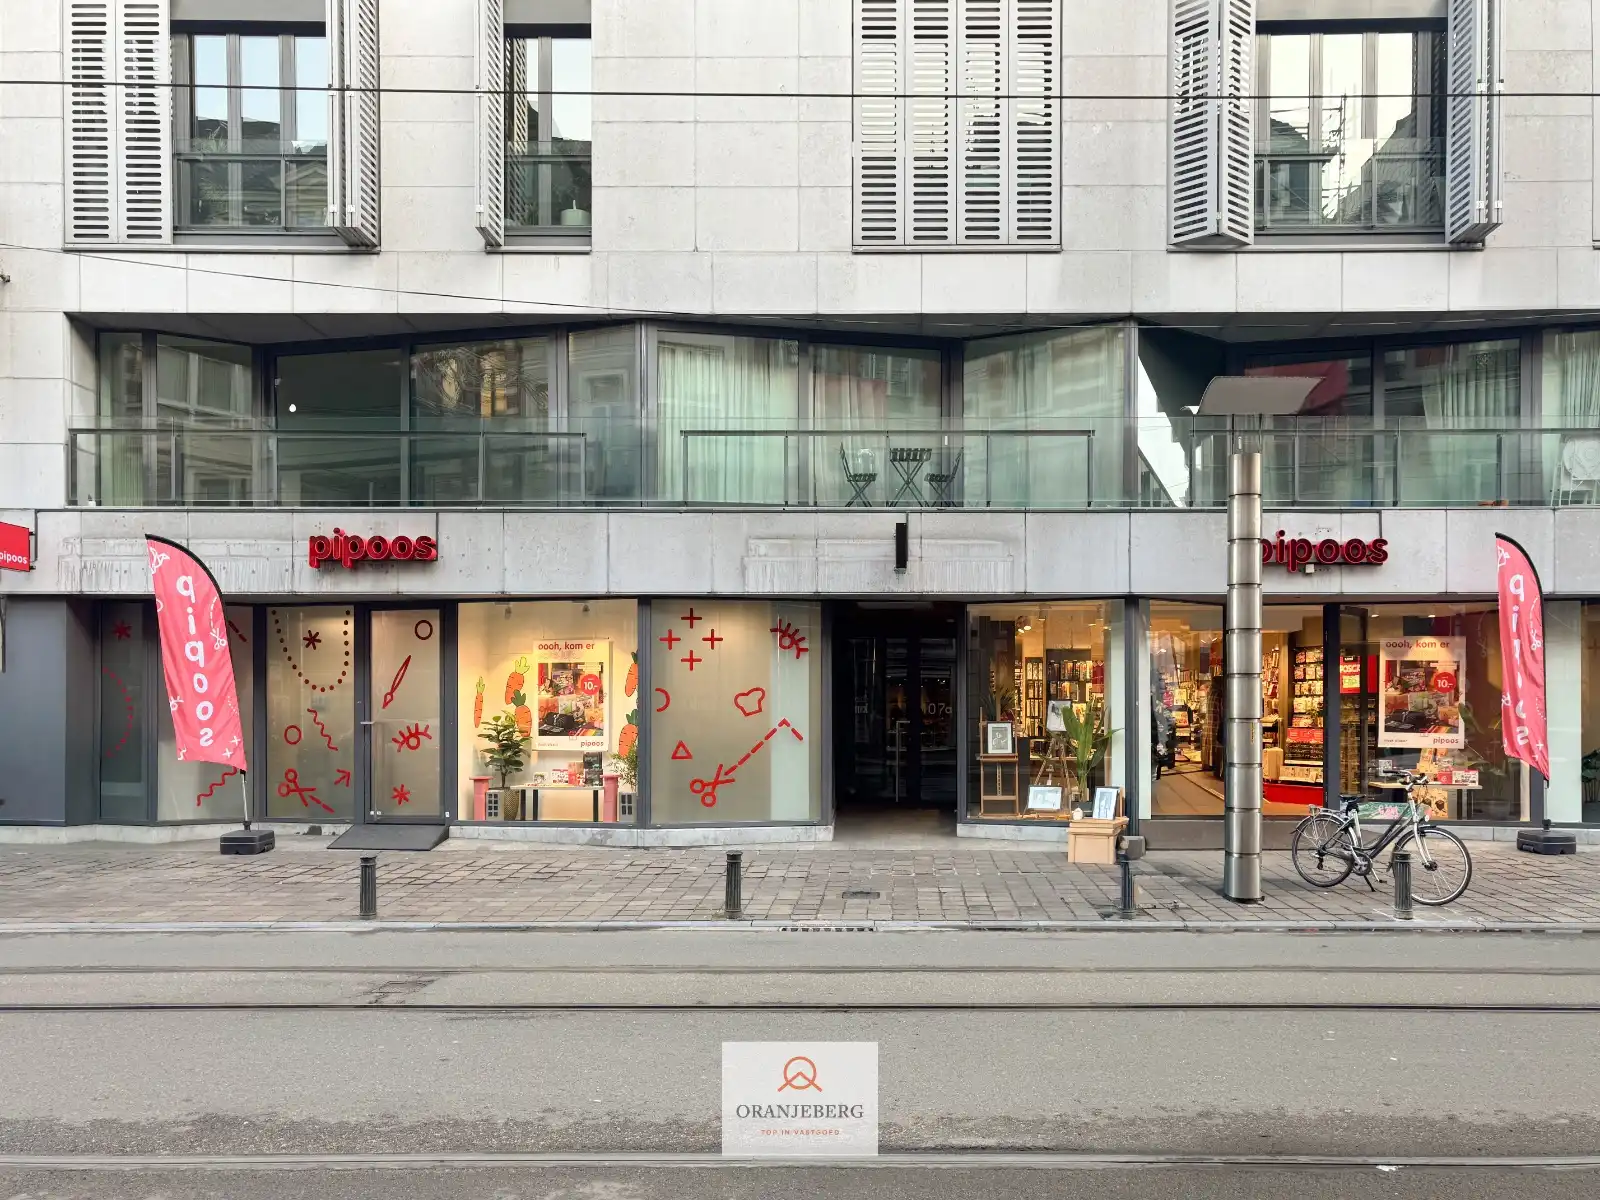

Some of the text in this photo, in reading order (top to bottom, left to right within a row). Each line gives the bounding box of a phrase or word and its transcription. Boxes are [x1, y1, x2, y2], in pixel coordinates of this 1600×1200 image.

[308, 527, 437, 569] pipoos
[538, 642, 562, 651] oooh,
[564, 642, 583, 650] kom
[1386, 640, 1412, 649] oooh,
[1415, 640, 1437, 648] kom
[580, 740, 604, 748] pipoos
[1433, 736, 1459, 745] pipoos
